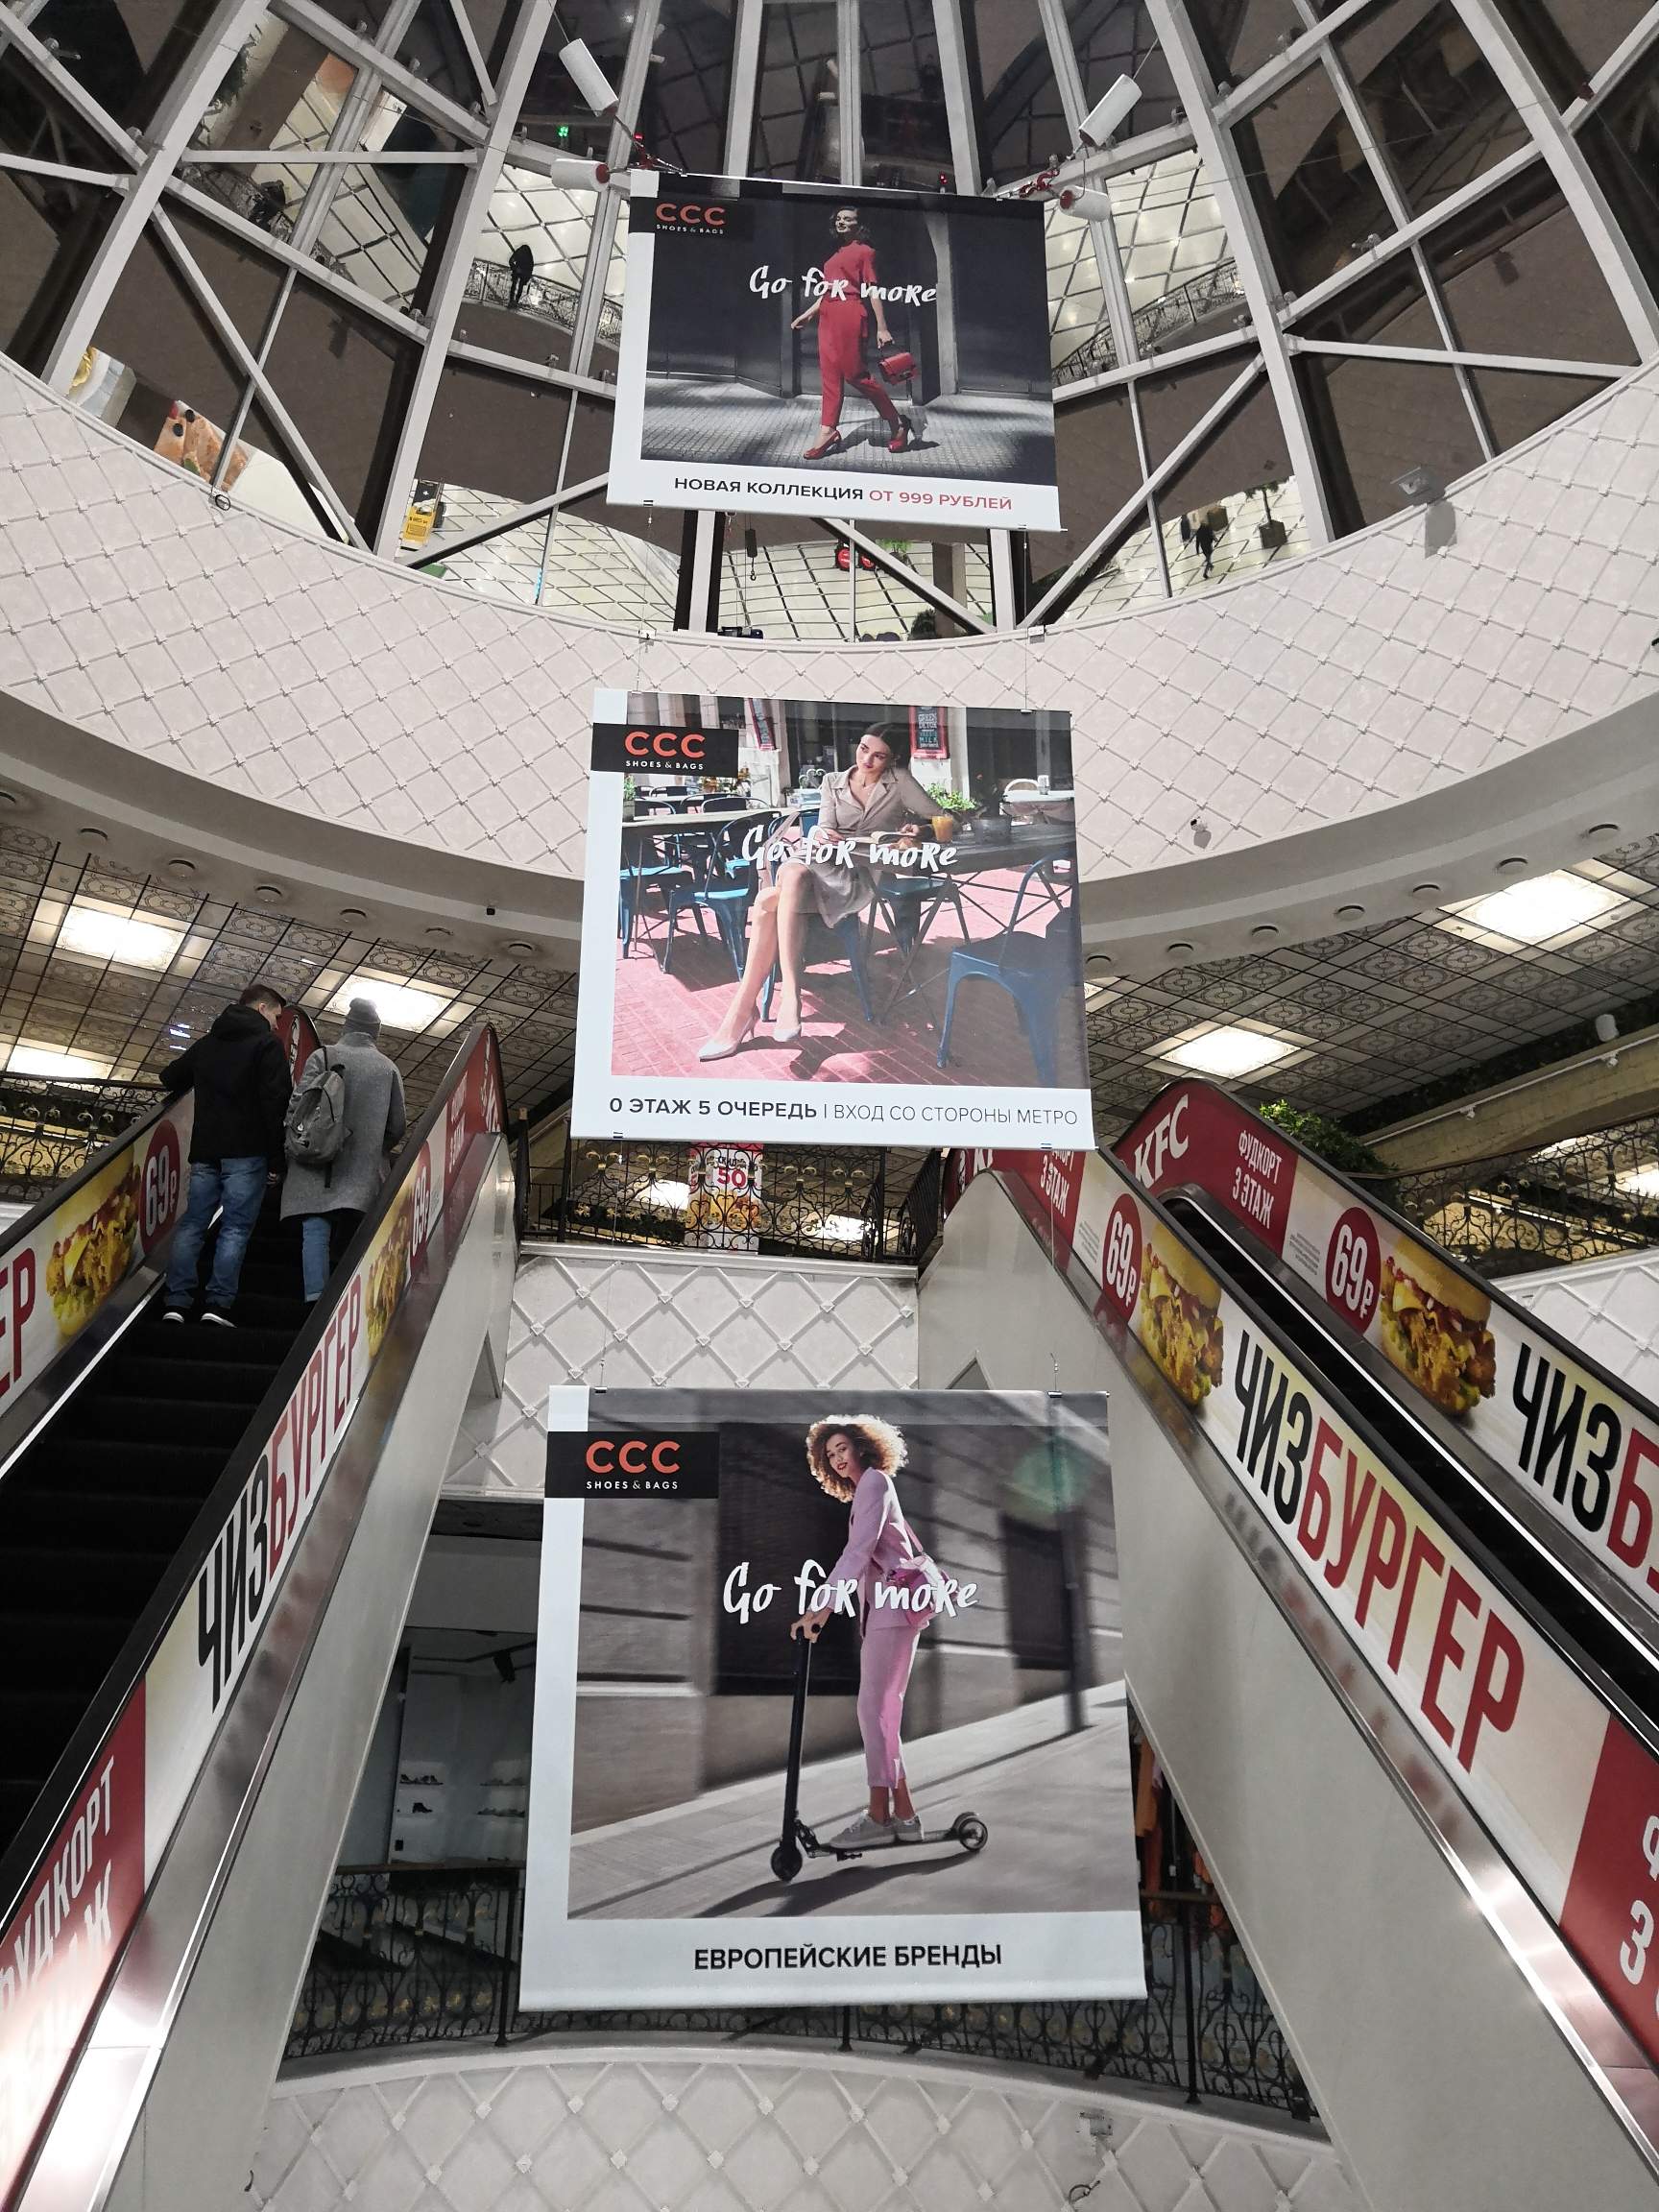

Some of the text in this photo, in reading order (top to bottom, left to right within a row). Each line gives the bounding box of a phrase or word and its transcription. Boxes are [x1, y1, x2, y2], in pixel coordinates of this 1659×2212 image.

[656, 203, 725, 226] CCC
[656, 224, 687, 233] SHOES
[749, 265, 793, 300] Go
[674, 477, 1012, 511] НОВАЯ КОЛЛЕКЦИЯ ОТ 999 РУБЛЕЙ
[624, 731, 706, 758] CCC
[625, 759, 661, 769] SHOES
[675, 761, 704, 770] BAGS
[741, 824, 789, 870] Go
[609, 1097, 623, 1113] 0
[629, 1098, 692, 1115] ЭТАЖ
[698, 1100, 711, 1115] 5
[717, 1101, 817, 1119] ОЧЕРЕДЬ
[833, 1104, 884, 1121] ВХОД
[889, 1106, 916, 1121] СО
[922, 1106, 1011, 1123] СТОРОНЫ
[1016, 1109, 1078, 1125] МЕТРО
[1135, 1094, 1189, 1190] KFC
[1238, 1130, 1283, 1185] ФУДКОРТ
[717, 1167, 747, 1189] 50
[1041, 1155, 1049, 1189] 3
[1232, 1166, 1275, 1230] 3 ЭТАЖ
[586, 1440, 681, 1474] CCC
[1512, 1342, 1659, 1595] ЧИЗБ
[198, 1273, 364, 1714] ЧИЗБУРГЕР
[586, 1479, 678, 1490] SHOES & BAGS
[1235, 1329, 1525, 1775] ЧИЗБУРГЕР
[723, 1561, 782, 1624] Go
[694, 1943, 1001, 1970] ЕВРОПЕЙСКИЕ БРЕНДЫ
